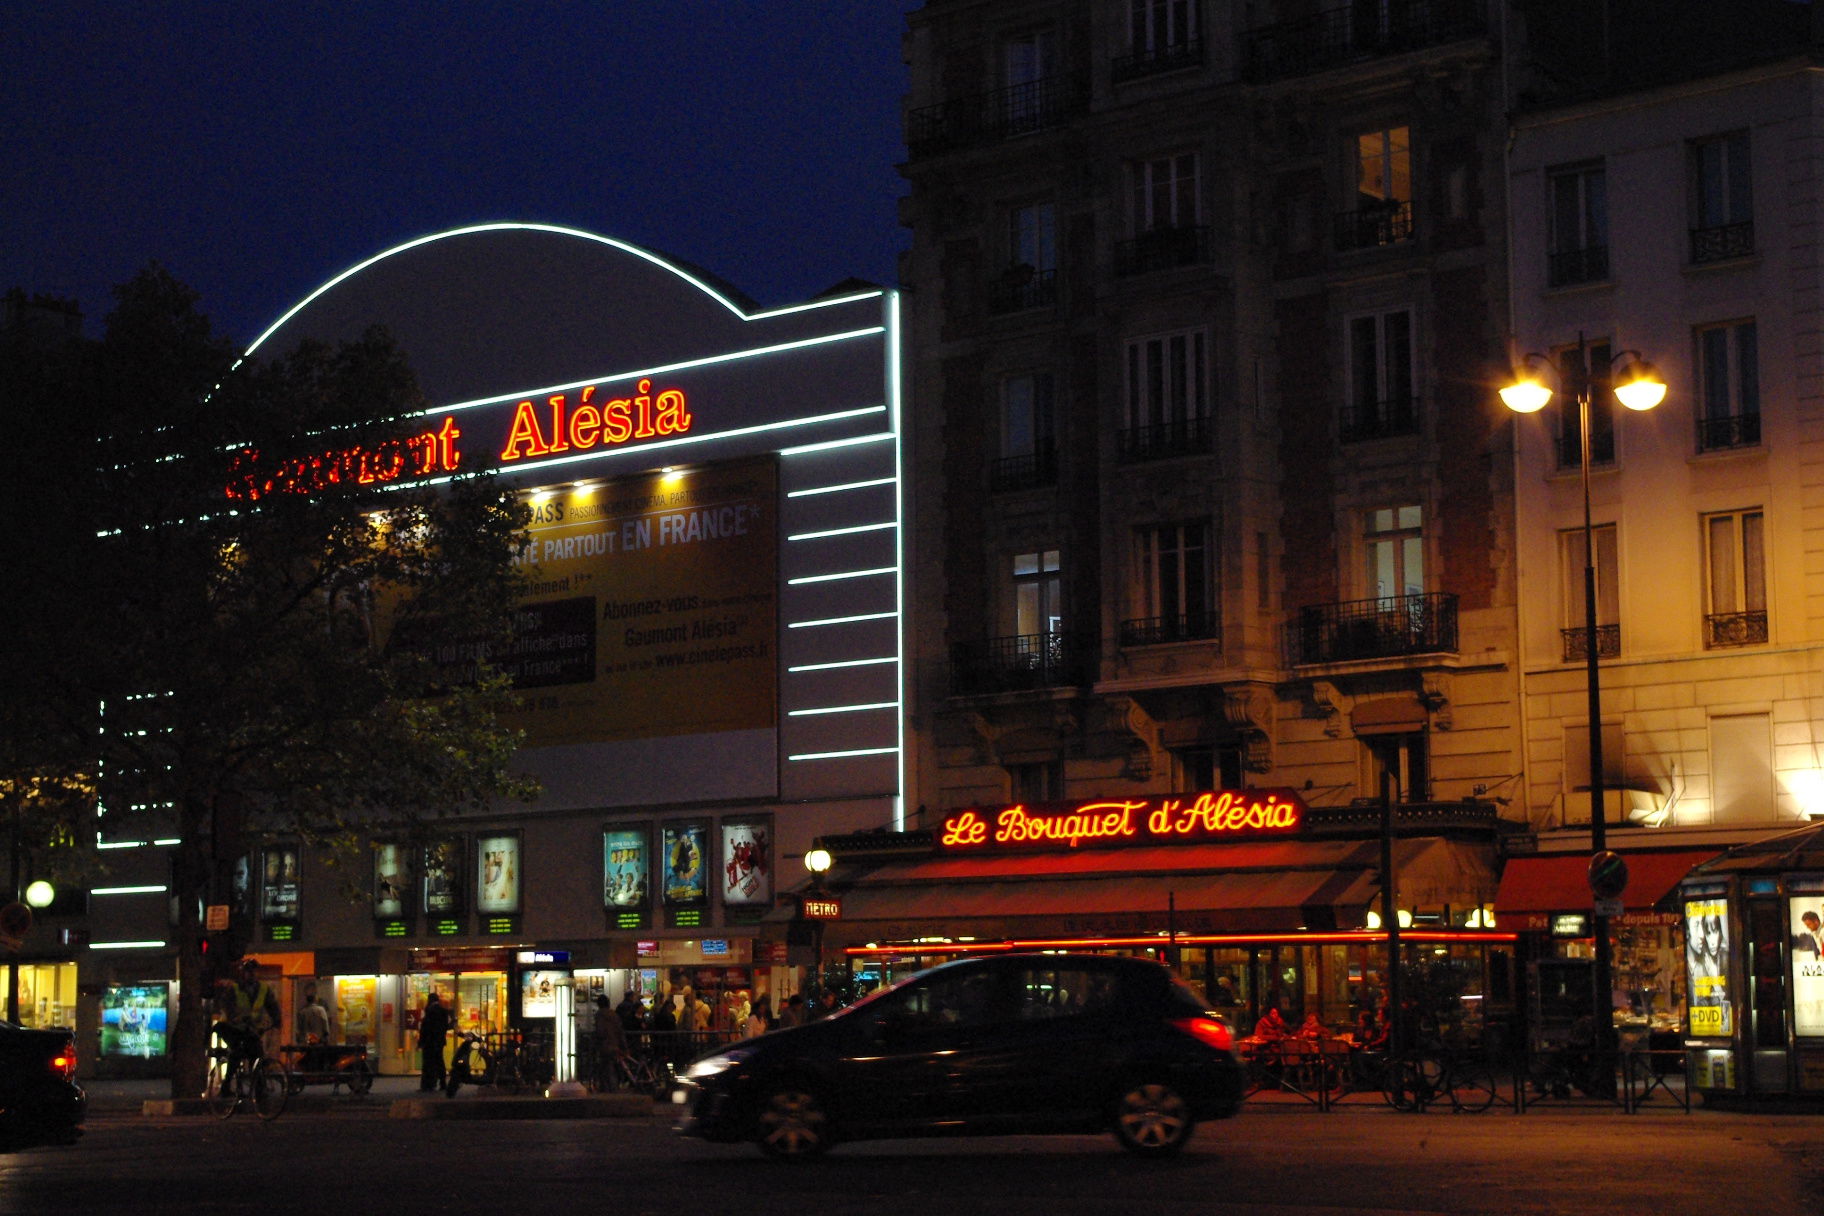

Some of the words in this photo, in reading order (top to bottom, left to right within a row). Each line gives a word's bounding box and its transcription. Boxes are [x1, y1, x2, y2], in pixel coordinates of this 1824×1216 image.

[501, 378, 691, 461] Alésia
[543, 531, 617, 562] PARTOUT
[621, 517, 652, 551] EN
[602, 594, 700, 621] Abonnez-vous
[624, 626, 687, 647] Gaumont
[655, 641, 770, 668] www.cinelepass.fr
[942, 811, 987, 846] Le
[995, 801, 1149, 848] Bouquet
[1148, 792, 1297, 834] d'Alésia
[805, 901, 839, 916] METRO
[1622, 912, 1661, 929] depuis
